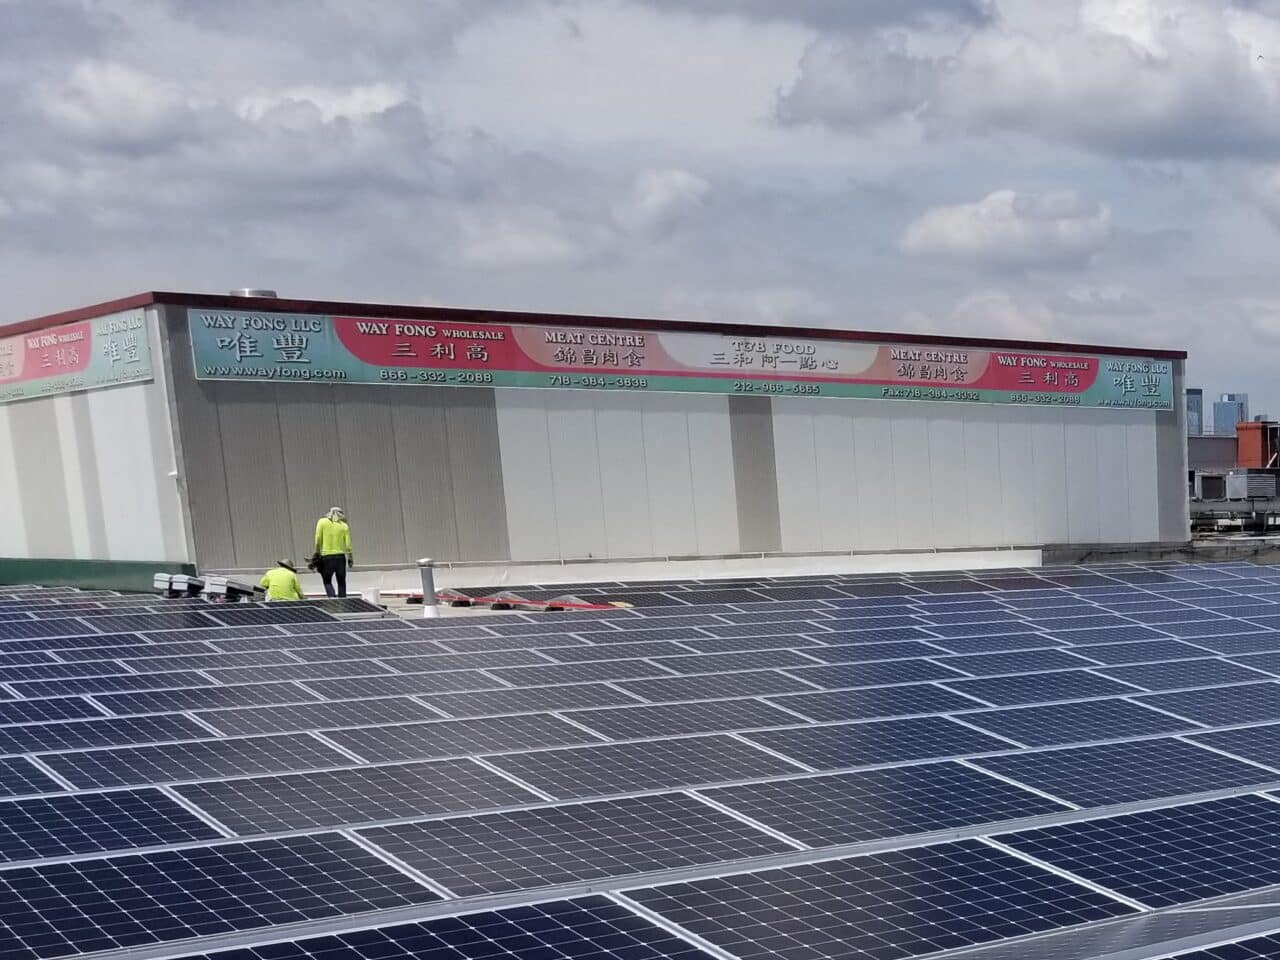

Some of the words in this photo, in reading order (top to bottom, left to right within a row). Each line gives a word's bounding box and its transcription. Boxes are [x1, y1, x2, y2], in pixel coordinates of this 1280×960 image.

[201, 314, 236, 329] WAY
[242, 316, 286, 331] FONG
[292, 319, 321, 332] LLC
[356, 322, 389, 335] WAY
[395, 324, 437, 337] FONG
[442, 329, 505, 341] WHOLESALE
[544, 331, 584, 345] MEAT
[588, 333, 645, 347] CENTRE
[215, 332, 311, 363] 唯豐
[391, 343, 489, 362] 三利高
[773, 343, 816, 355] FOOD
[890, 349, 921, 361] MEAT
[924, 351, 968, 364] CENTRE
[998, 356, 1018, 367] WAY
[1021, 357, 1047, 368] FONG
[1050, 360, 1089, 370] WHOLESALE
[204, 365, 347, 379] www.wayfong.com
[1106, 361, 1124, 373] WAY
[1126, 363, 1149, 374] FONG
[1151, 364, 1168, 375] LLC
[379, 369, 493, 383] 866-332-2088
[1018, 372, 1079, 387] 三利高
